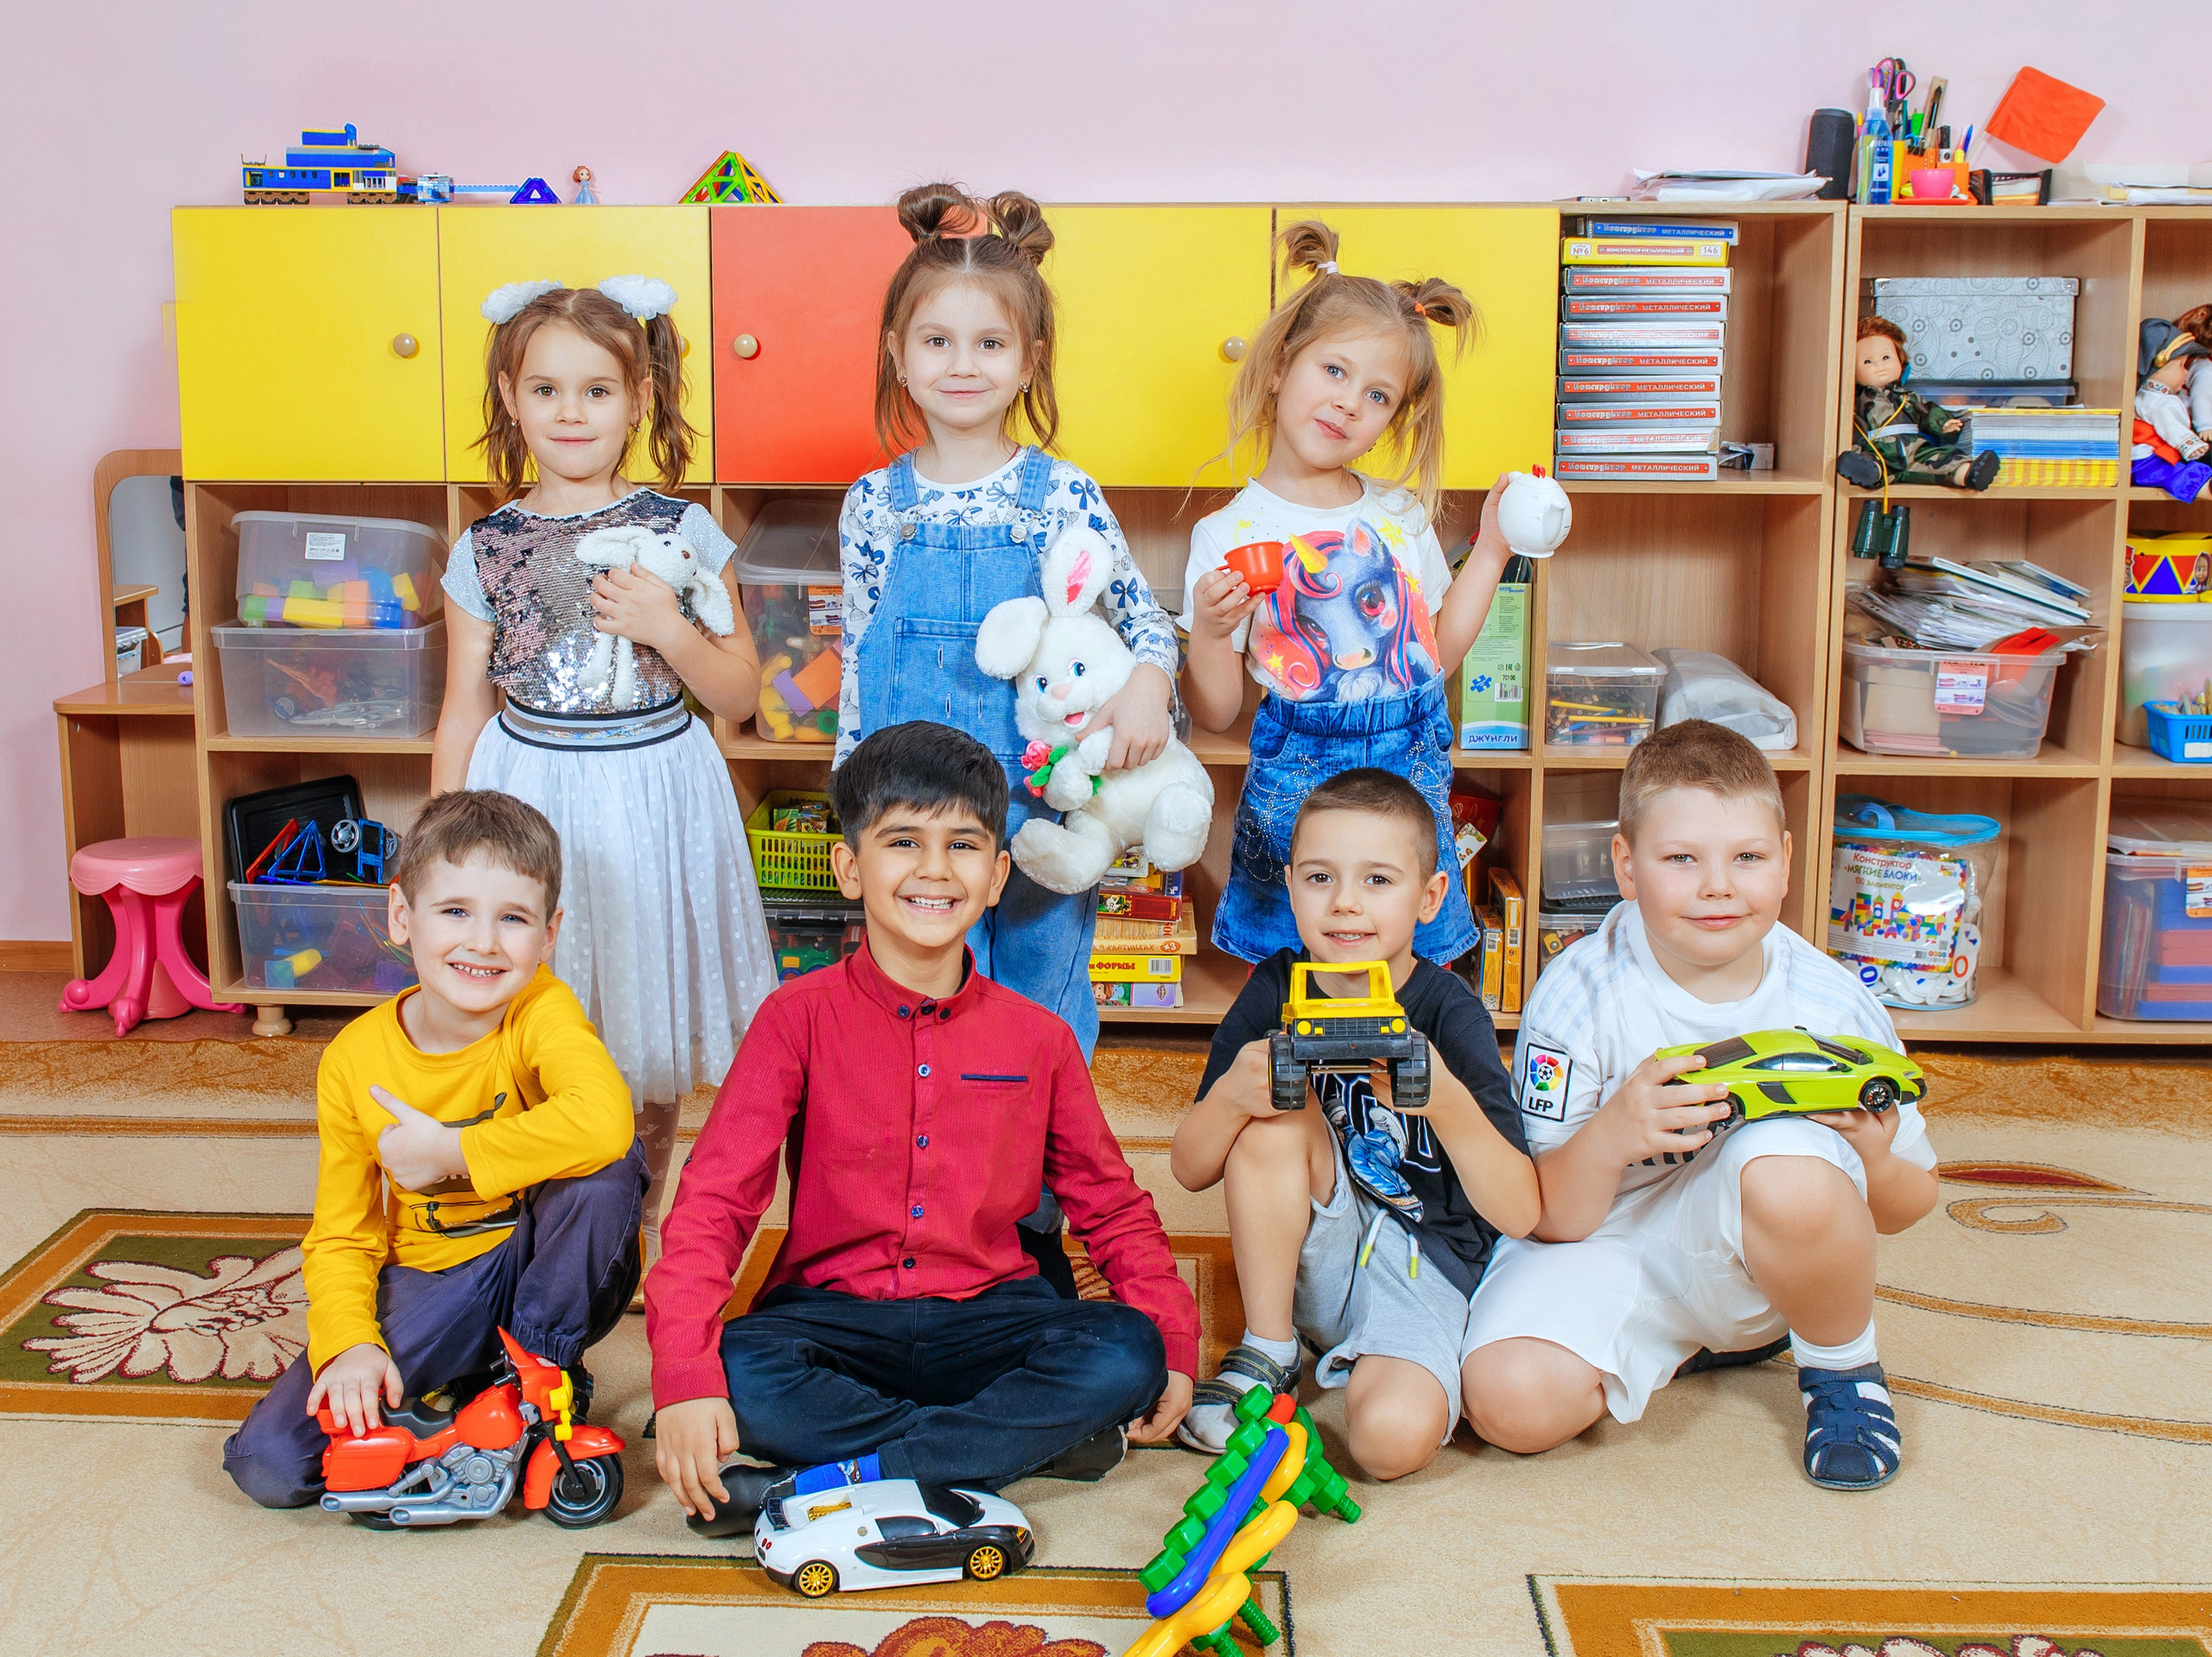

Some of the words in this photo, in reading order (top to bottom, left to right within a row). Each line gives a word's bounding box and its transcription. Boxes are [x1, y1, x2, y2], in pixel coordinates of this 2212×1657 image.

[1662, 228, 1725, 237] МЕТАЛЛИЧЕСКИЙ
[1853, 853, 1911, 870] Конструктор
[1855, 876, 1865, 886] 100
[1096, 962, 1135, 970] ФОРМЫ
[1529, 1096, 1554, 1112] LFP
